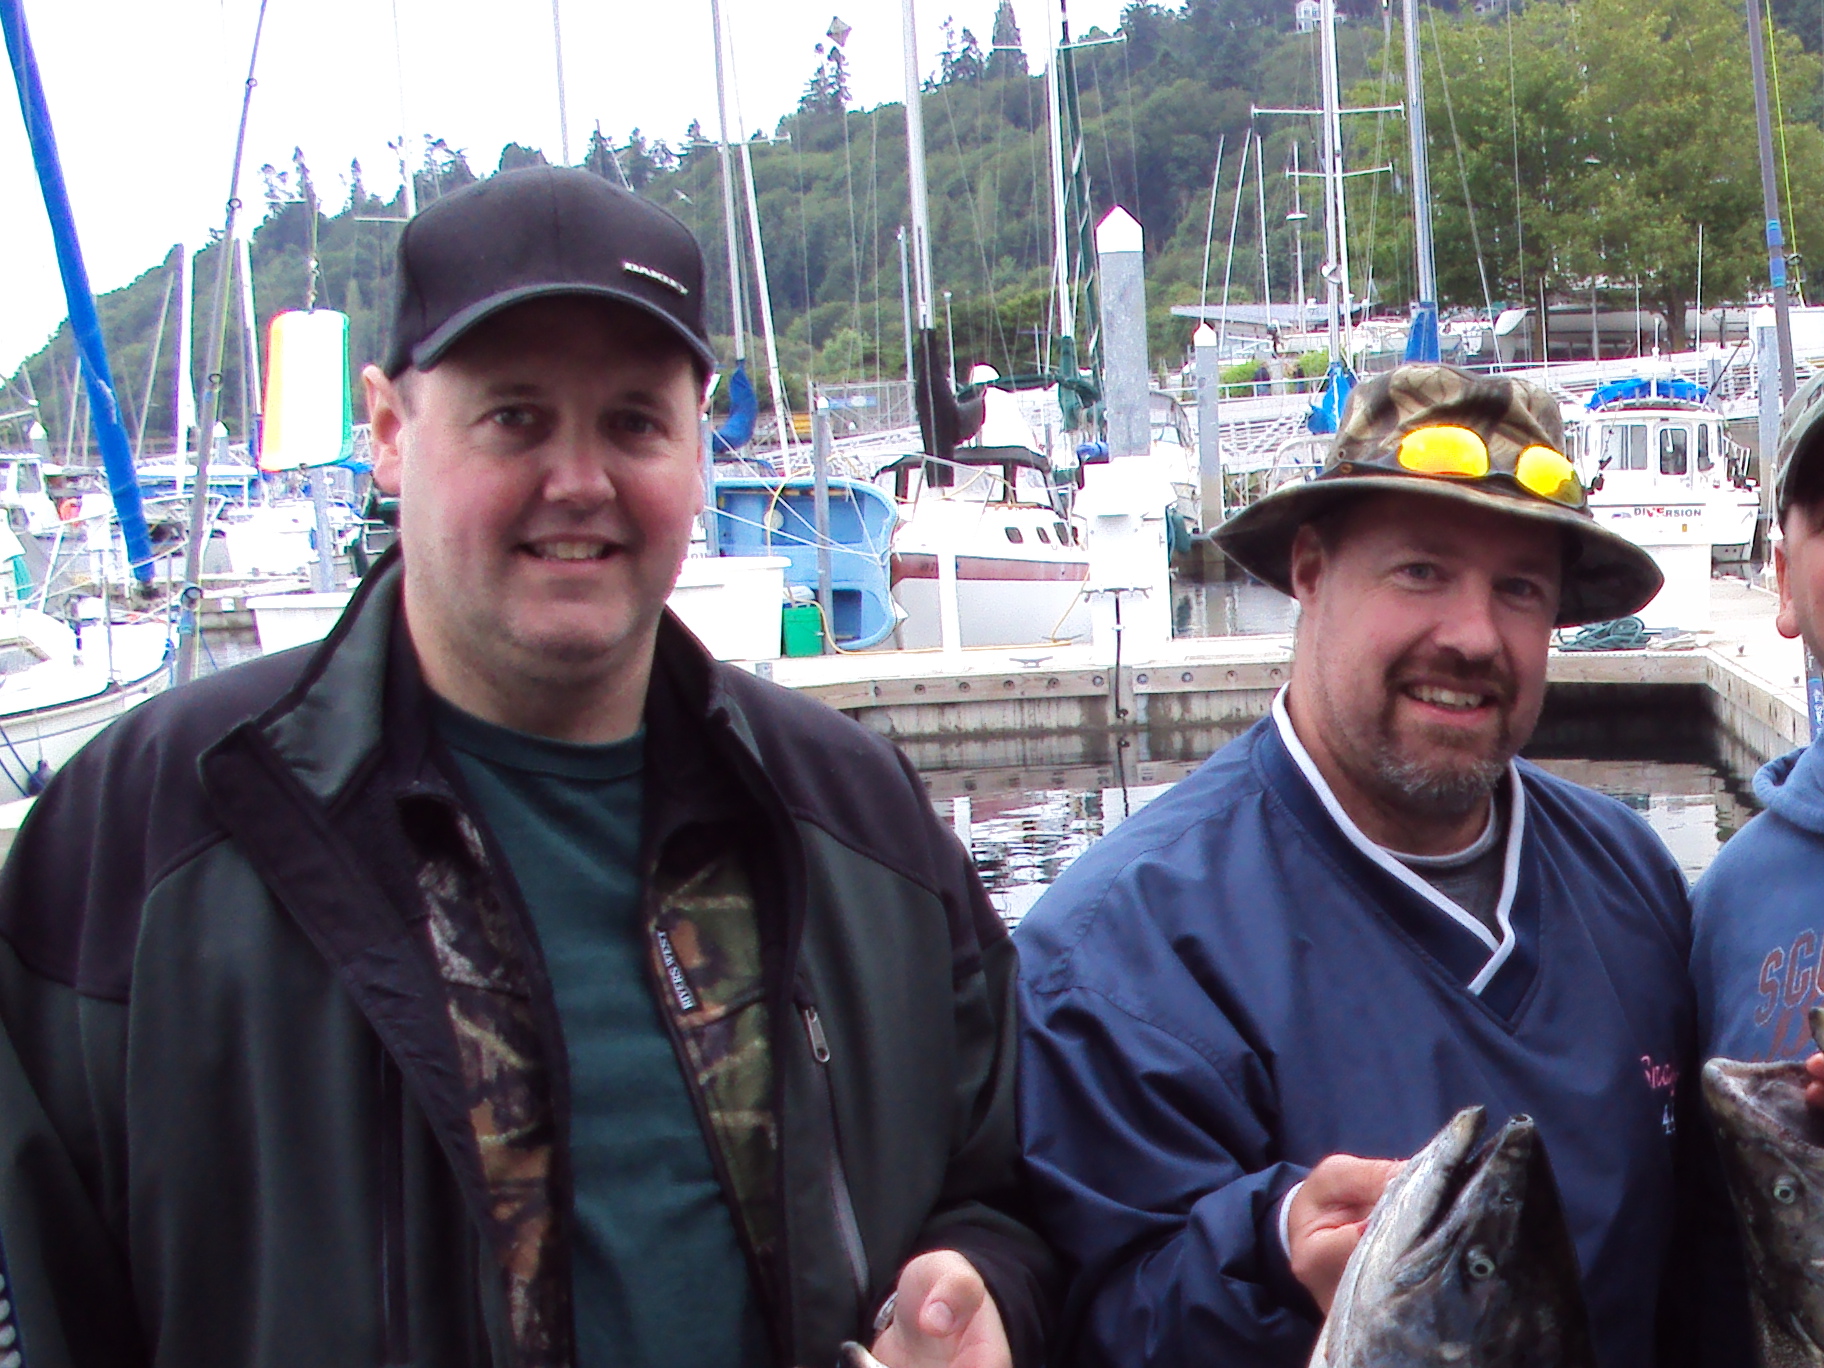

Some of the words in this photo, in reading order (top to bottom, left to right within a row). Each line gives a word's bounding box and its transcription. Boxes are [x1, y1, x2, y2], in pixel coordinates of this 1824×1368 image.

[1634, 506, 1701, 517] DIVERSION
[657, 931, 676, 968] WEST
[668, 966, 697, 1010] RIVERS
